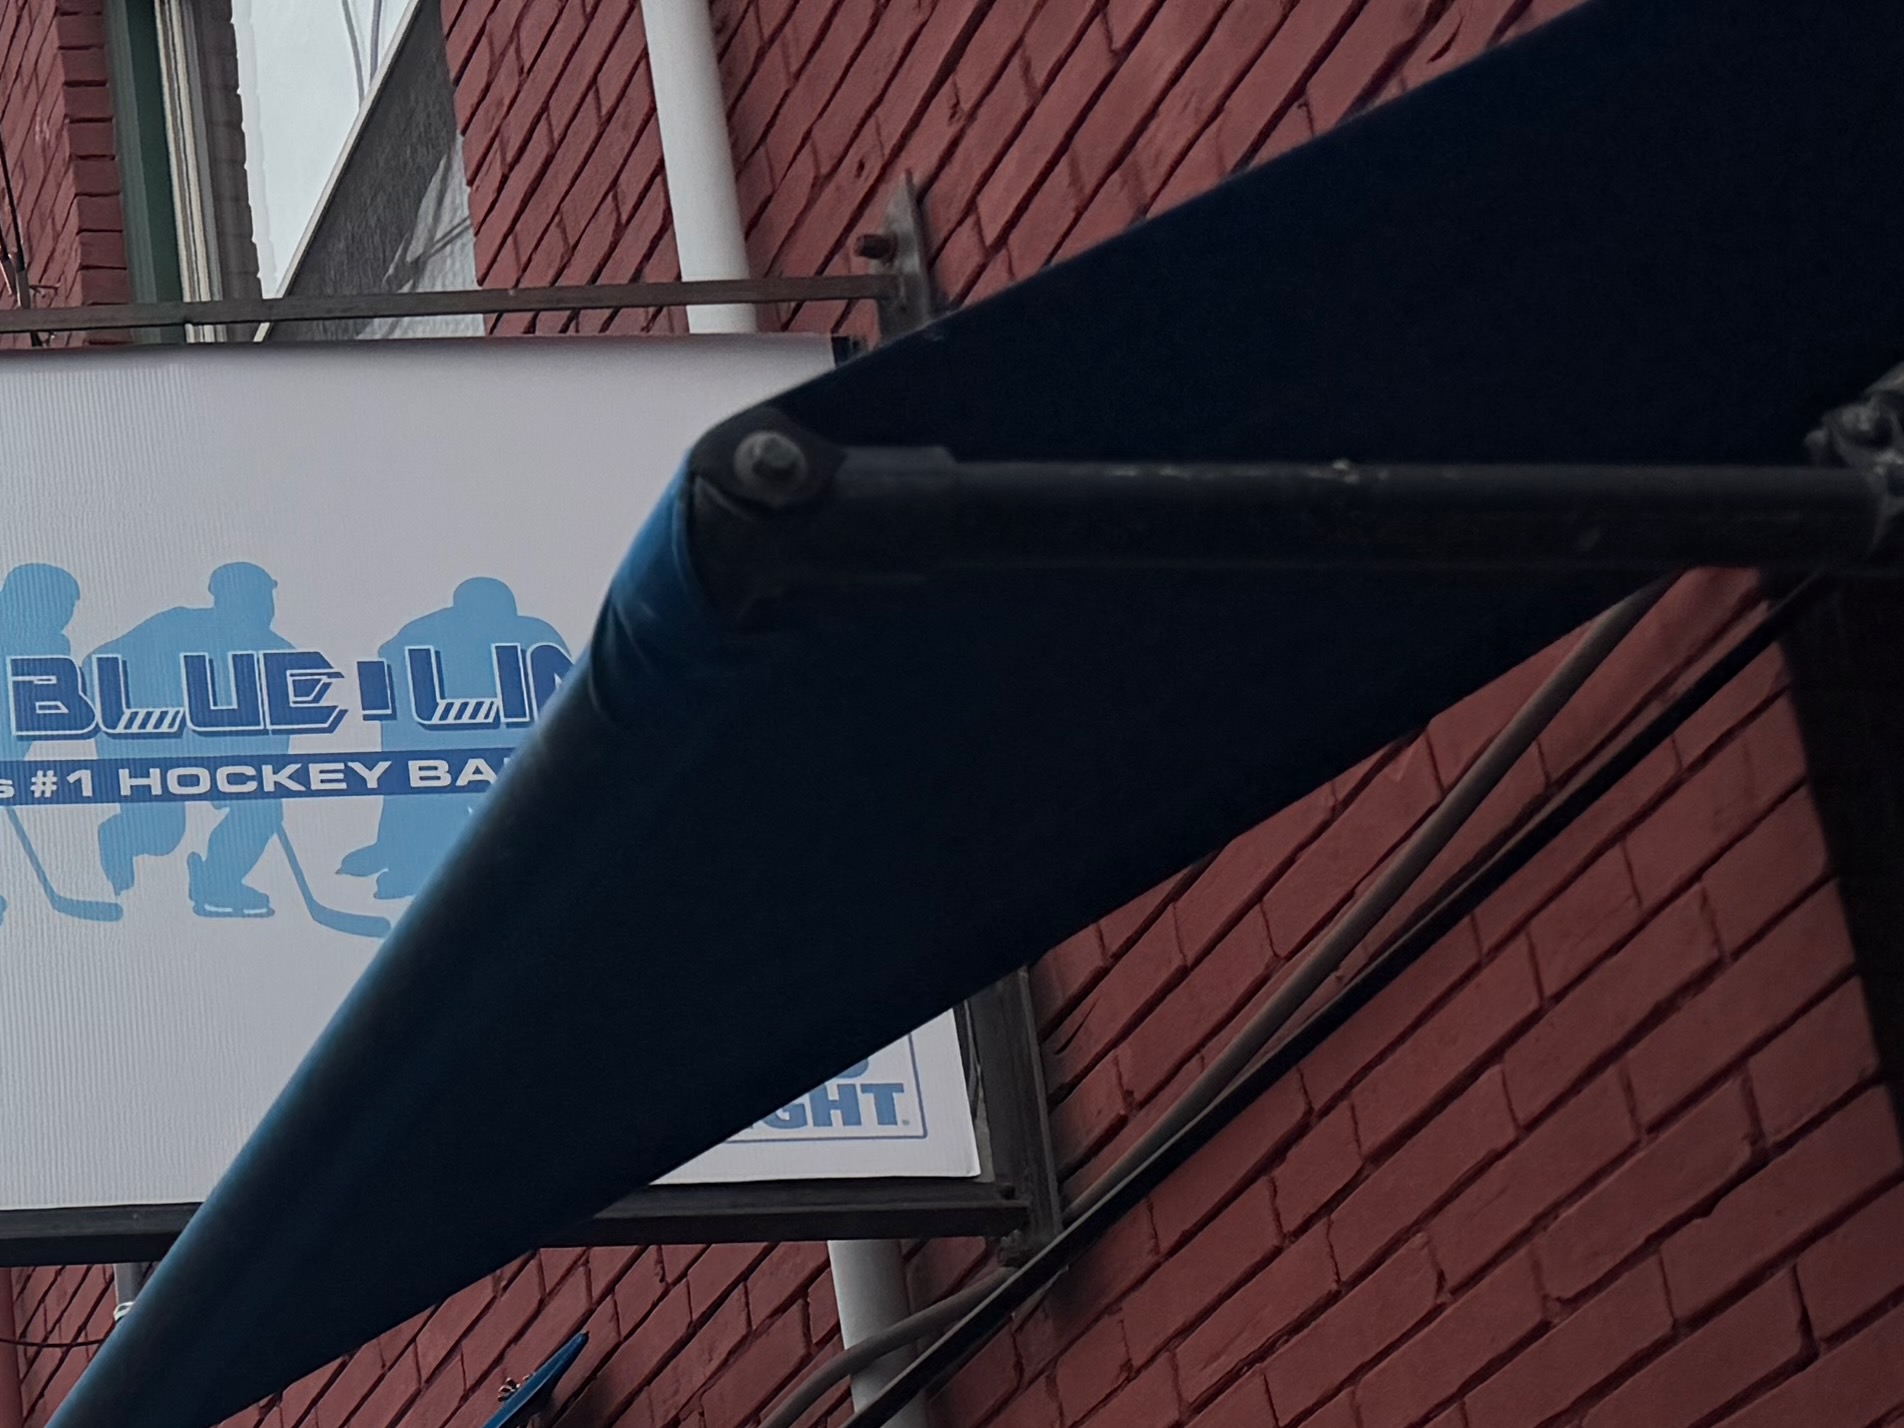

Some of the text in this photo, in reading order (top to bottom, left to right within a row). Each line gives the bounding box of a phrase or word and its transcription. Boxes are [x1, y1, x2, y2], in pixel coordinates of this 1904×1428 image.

[7, 648, 349, 742] BLUE
[404, 643, 578, 732] LIN
[30, 768, 93, 799] #1
[119, 759, 393, 797] HOCKEY
[408, 757, 510, 789] BA
[752, 1082, 905, 1130] GHT
